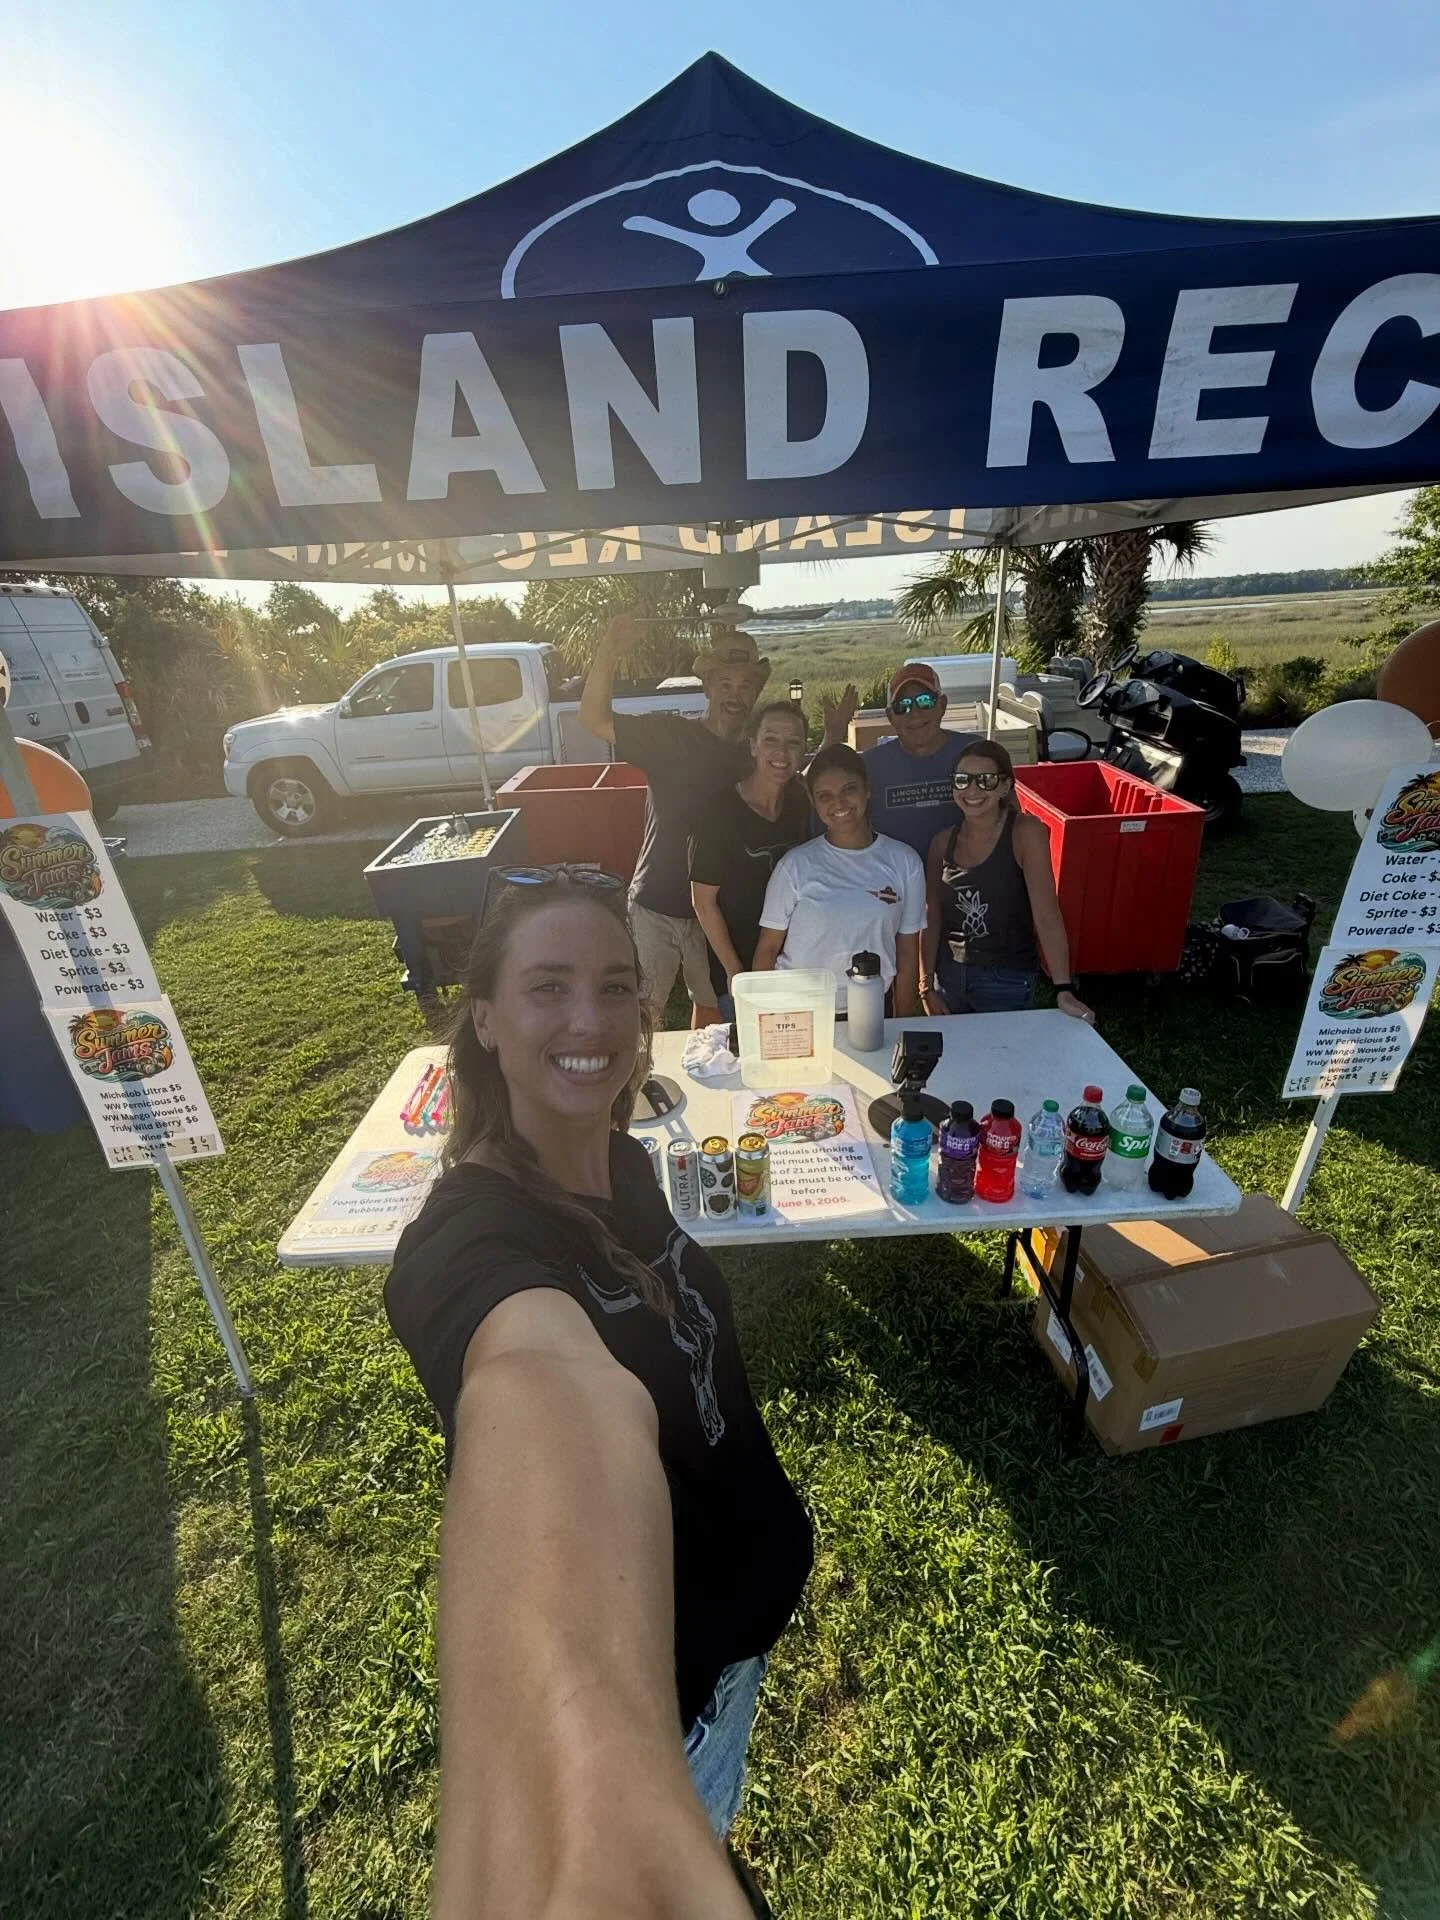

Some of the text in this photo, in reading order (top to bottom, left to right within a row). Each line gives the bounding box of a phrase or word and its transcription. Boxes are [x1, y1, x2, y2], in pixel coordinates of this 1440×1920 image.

[0, 272, 1440, 519] ISLAND REC
[1, 842, 93, 881] Summer
[1385, 855, 1427, 866] Water
[21, 862, 82, 898] Jams
[1382, 872, 1417, 884] Coke
[1360, 890, 1389, 902] Diet
[1392, 889, 1427, 901] Coke
[35, 911, 74, 923] Water
[84, 907, 103, 920] $3
[1366, 907, 1408, 921] Sprite
[1419, 905, 1438, 918] $3
[47, 929, 80, 941] Coke
[89, 926, 108, 939] $3
[1348, 924, 1415, 936] Powerade
[40, 947, 69, 960] Diet
[69, 945, 103, 958] Coke
[112, 942, 131, 955] $3
[59, 964, 99, 981] Sprite
[108, 961, 126, 974] $3
[54, 980, 119, 996] Powerade
[127, 977, 145, 991] $3
[1322, 965, 1424, 997] Summer
[1336, 983, 1400, 1012] Jams
[776, 1022, 797, 1030] TIPS
[1318, 1027, 1362, 1036] Michelob
[1364, 1026, 1387, 1034] Ultra
[75, 1022, 169, 1059] Summer
[1316, 1038, 1333, 1046] WW
[94, 1040, 154, 1074] Jams
[1305, 1049, 1323, 1057] WW
[1306, 1059, 1328, 1068] Truly
[1330, 1057, 1351, 1066] Wild
[1352, 1056, 1378, 1065] Berry
[1328, 1066, 1350, 1074] Wine
[100, 1083, 183, 1100] Michelob Ultra $5
[104, 1094, 186, 1111] WW Pernicious $6
[102, 1114, 121, 1122] WW
[121, 1111, 151, 1122] Mango
[185, 1104, 198, 1114] $6
[746, 1102, 842, 1128] Summer
[110, 1116, 199, 1134] Truly Wild Berry $6
[765, 1114, 824, 1138] Jams
[139, 1130, 175, 1142] Wine $7
[812, 1145, 855, 1155] drinking
[788, 1156, 815, 1165] must
[817, 1154, 830, 1163] be
[832, 1153, 843, 1162] of
[846, 1153, 864, 1161] the
[780, 1166, 790, 1175] of
[793, 1167, 804, 1175] 21
[807, 1165, 827, 1174] and
[830, 1163, 856, 1172] their
[798, 1176, 827, 1185] must
[828, 1174, 842, 1183] be
[844, 1174, 859, 1182] on
[860, 1173, 873, 1181] or
[678, 1172, 691, 1211] ULTRA
[791, 1186, 827, 1196] before
[777, 1198, 802, 1209] June
